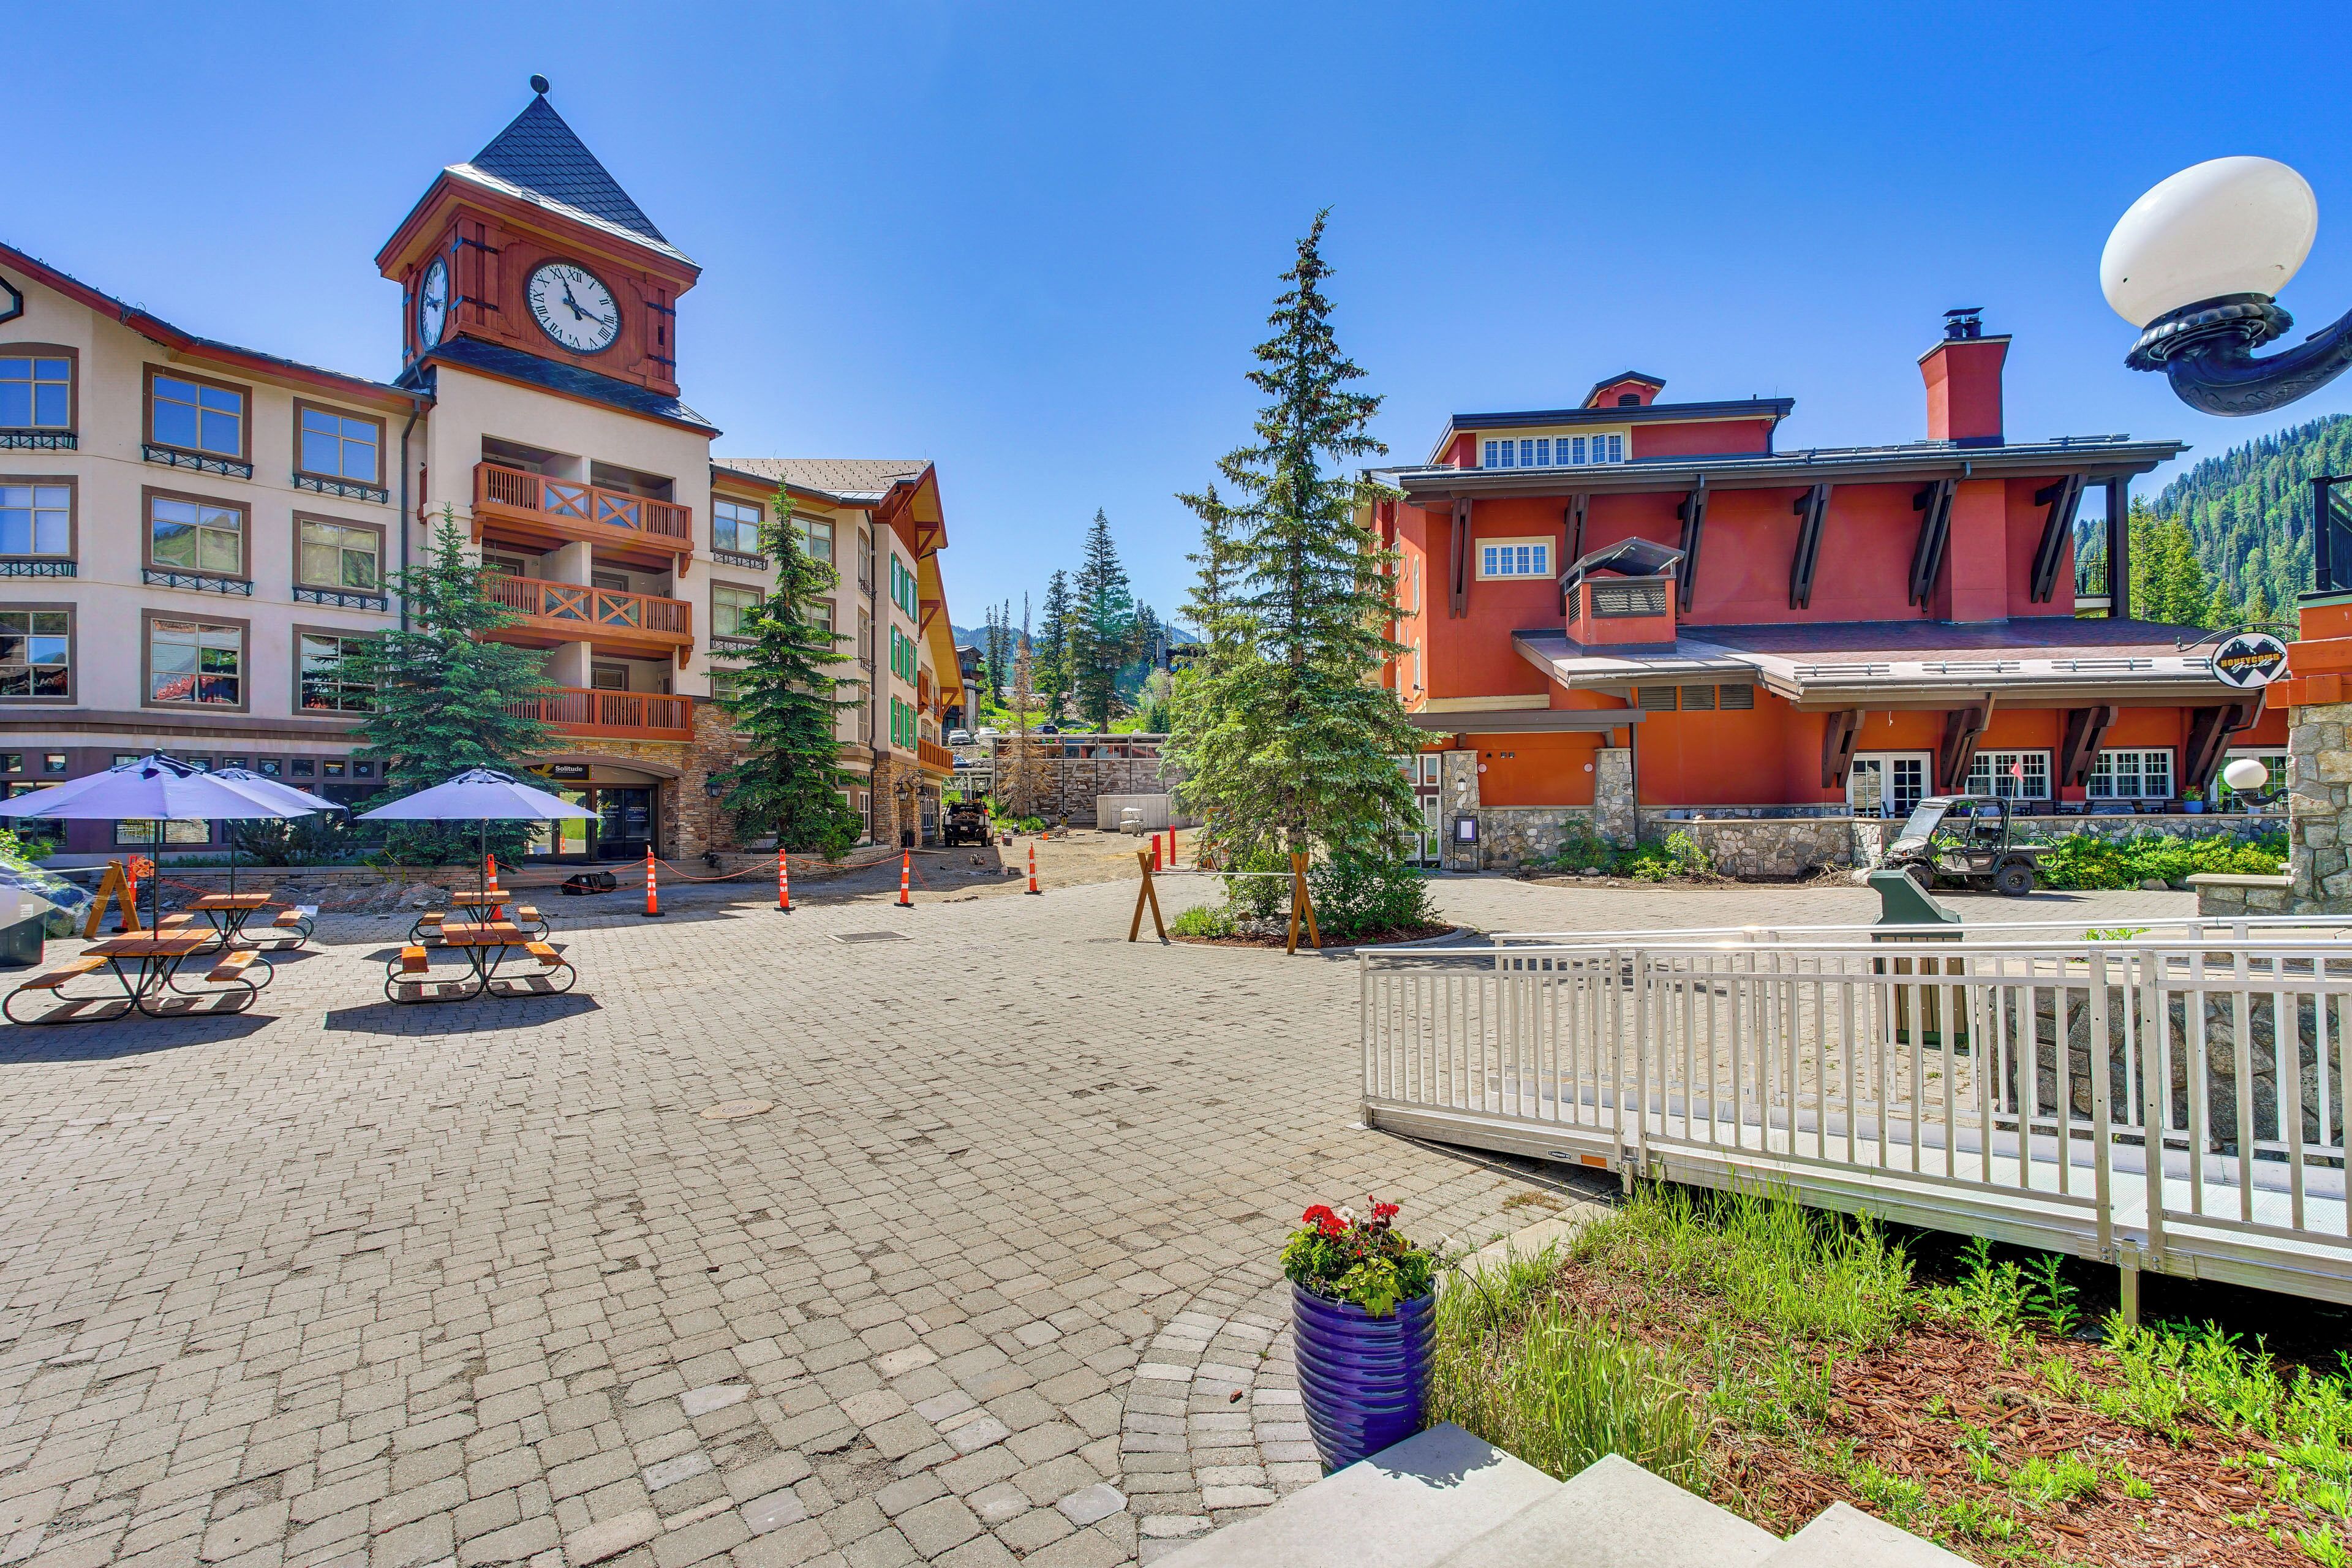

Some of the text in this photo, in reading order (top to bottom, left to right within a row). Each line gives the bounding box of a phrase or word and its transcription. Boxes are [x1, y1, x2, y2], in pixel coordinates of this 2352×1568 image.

[537, 274, 551, 288] X
[567, 268, 582, 284] XII
[588, 281, 596, 290] I
[533, 288, 545, 303] IX
[535, 305, 551, 323] VIII
[603, 314, 614, 325] III
[549, 322, 563, 339] VII
[589, 337, 598, 348] V
[2220, 653, 2281, 668] HONEYCOMB
[2231, 658, 2274, 674] Grill
